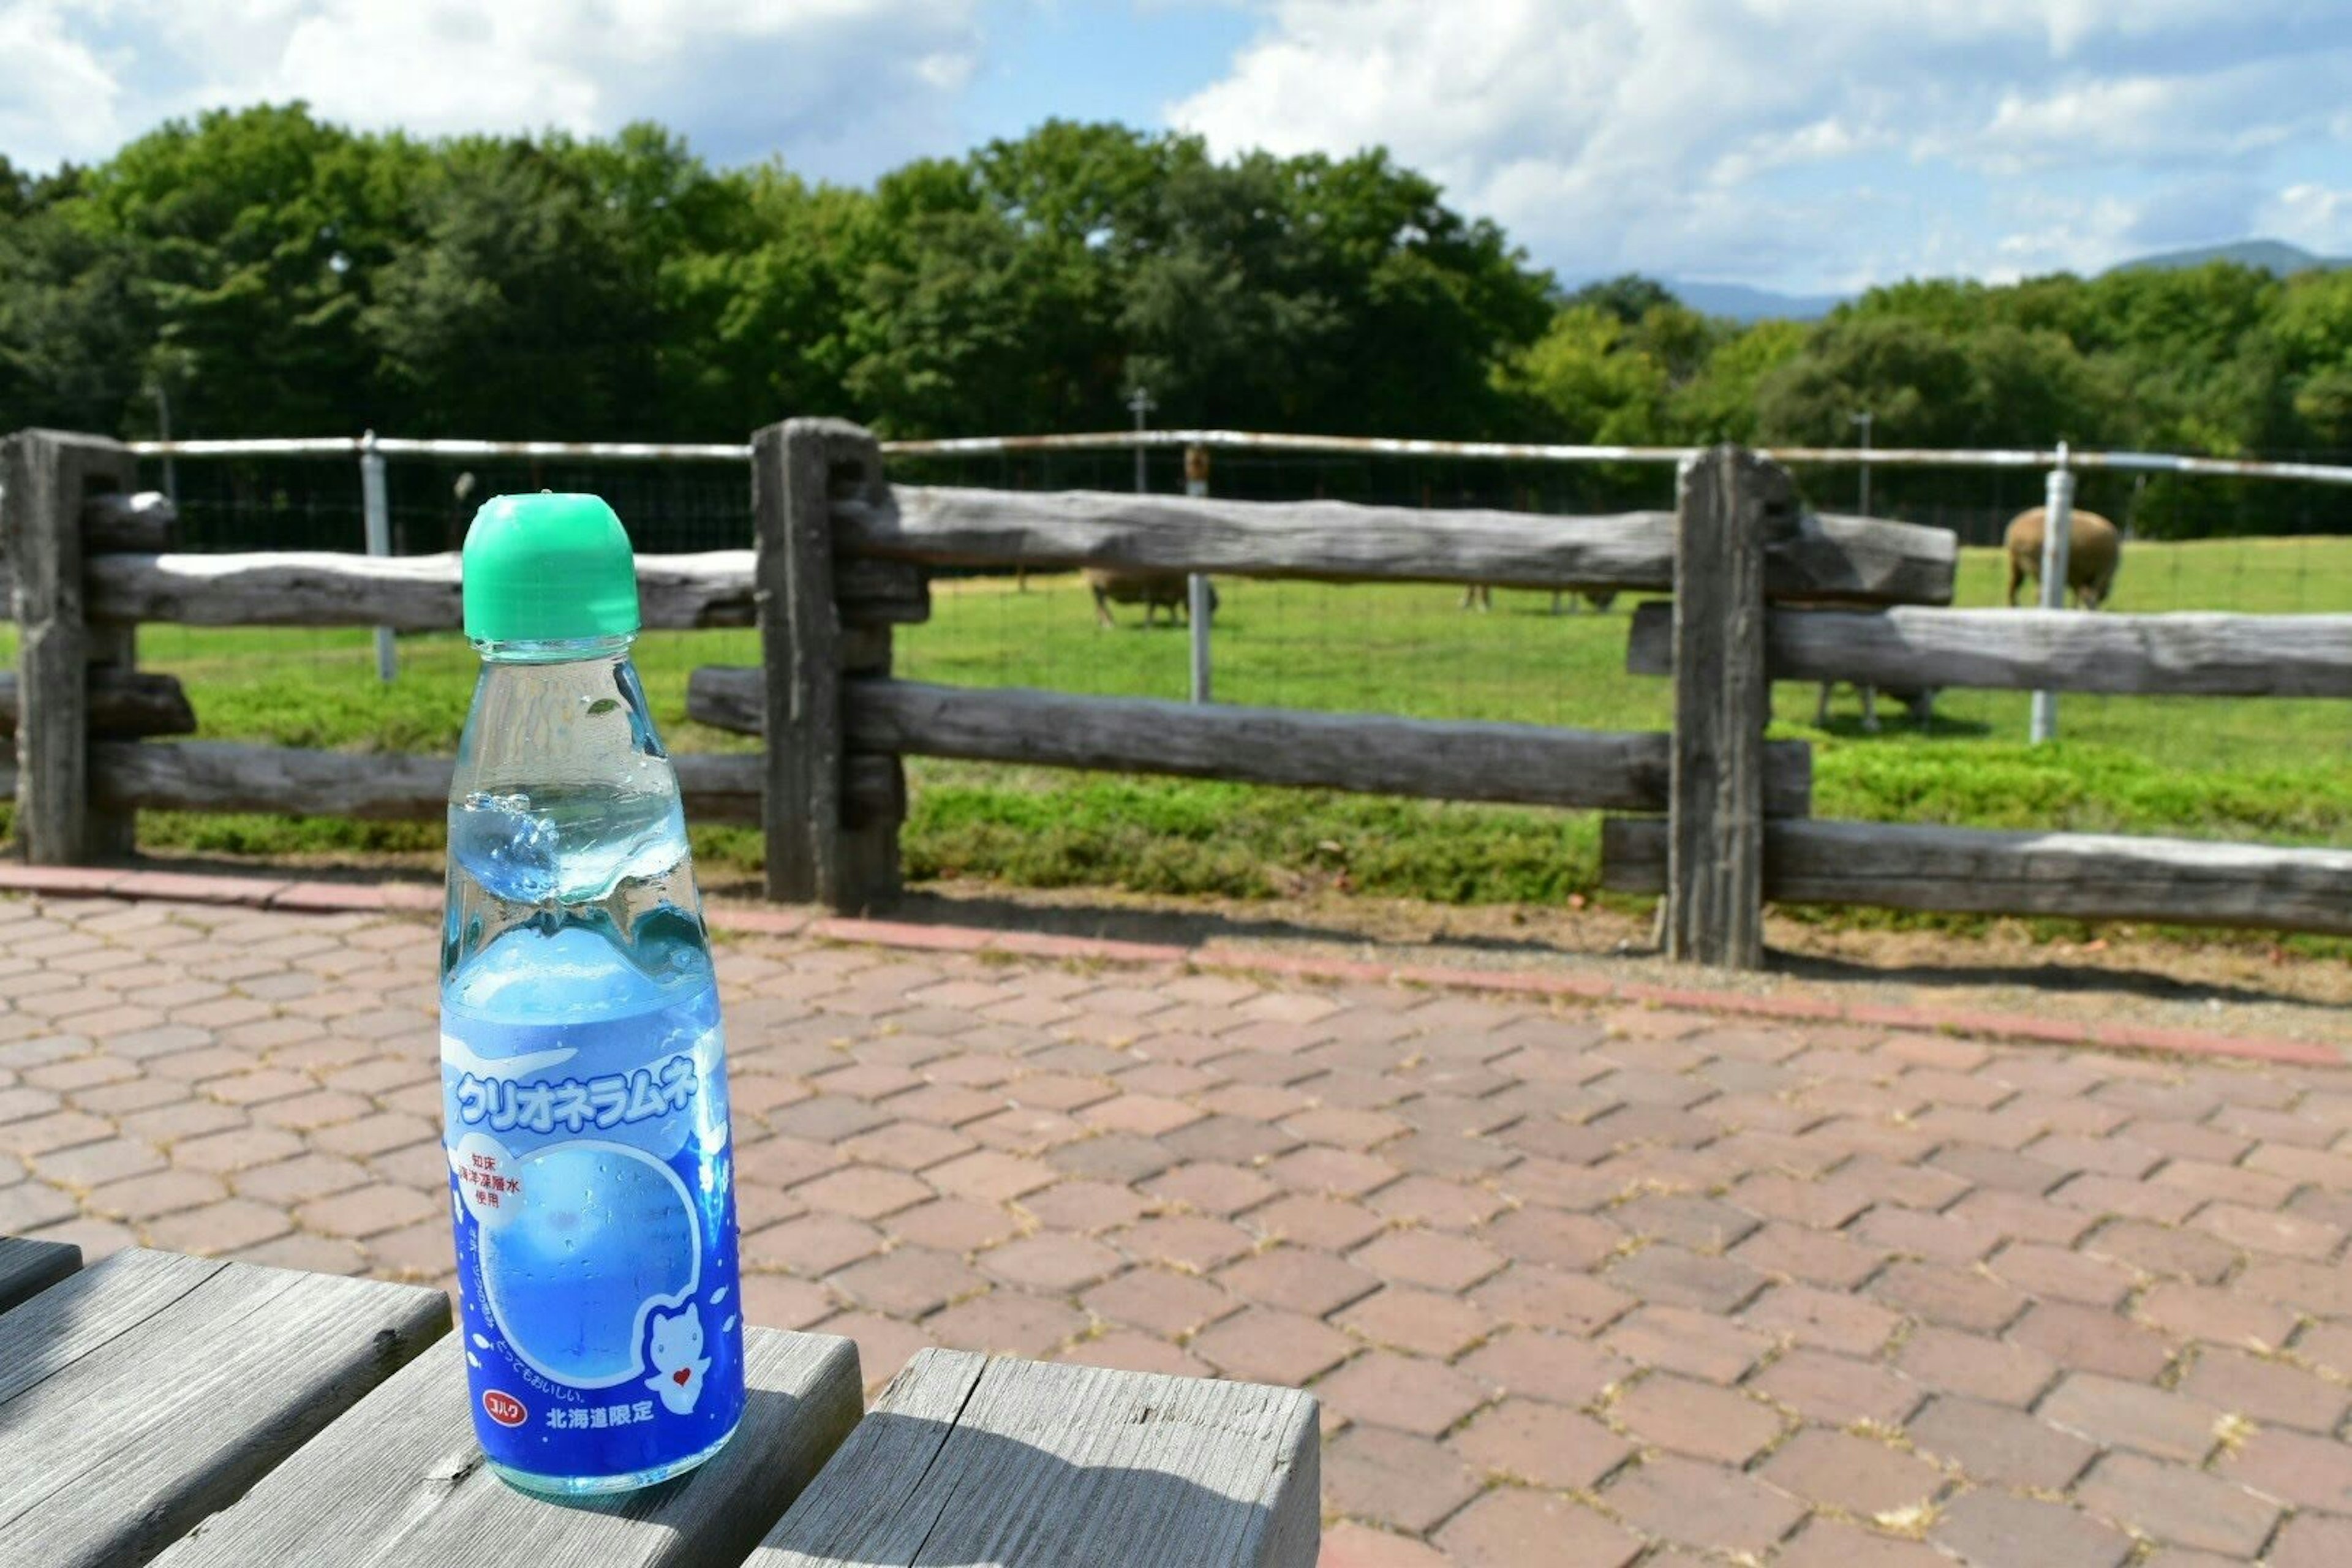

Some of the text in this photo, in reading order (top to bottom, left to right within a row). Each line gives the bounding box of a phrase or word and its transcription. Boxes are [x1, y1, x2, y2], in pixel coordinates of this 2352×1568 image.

[458, 1057, 697, 1133] クリオネラムネ
[472, 1153, 496, 1170] 知床
[476, 1190, 499, 1208] 使用
[546, 1401, 654, 1429] 北海道限定
